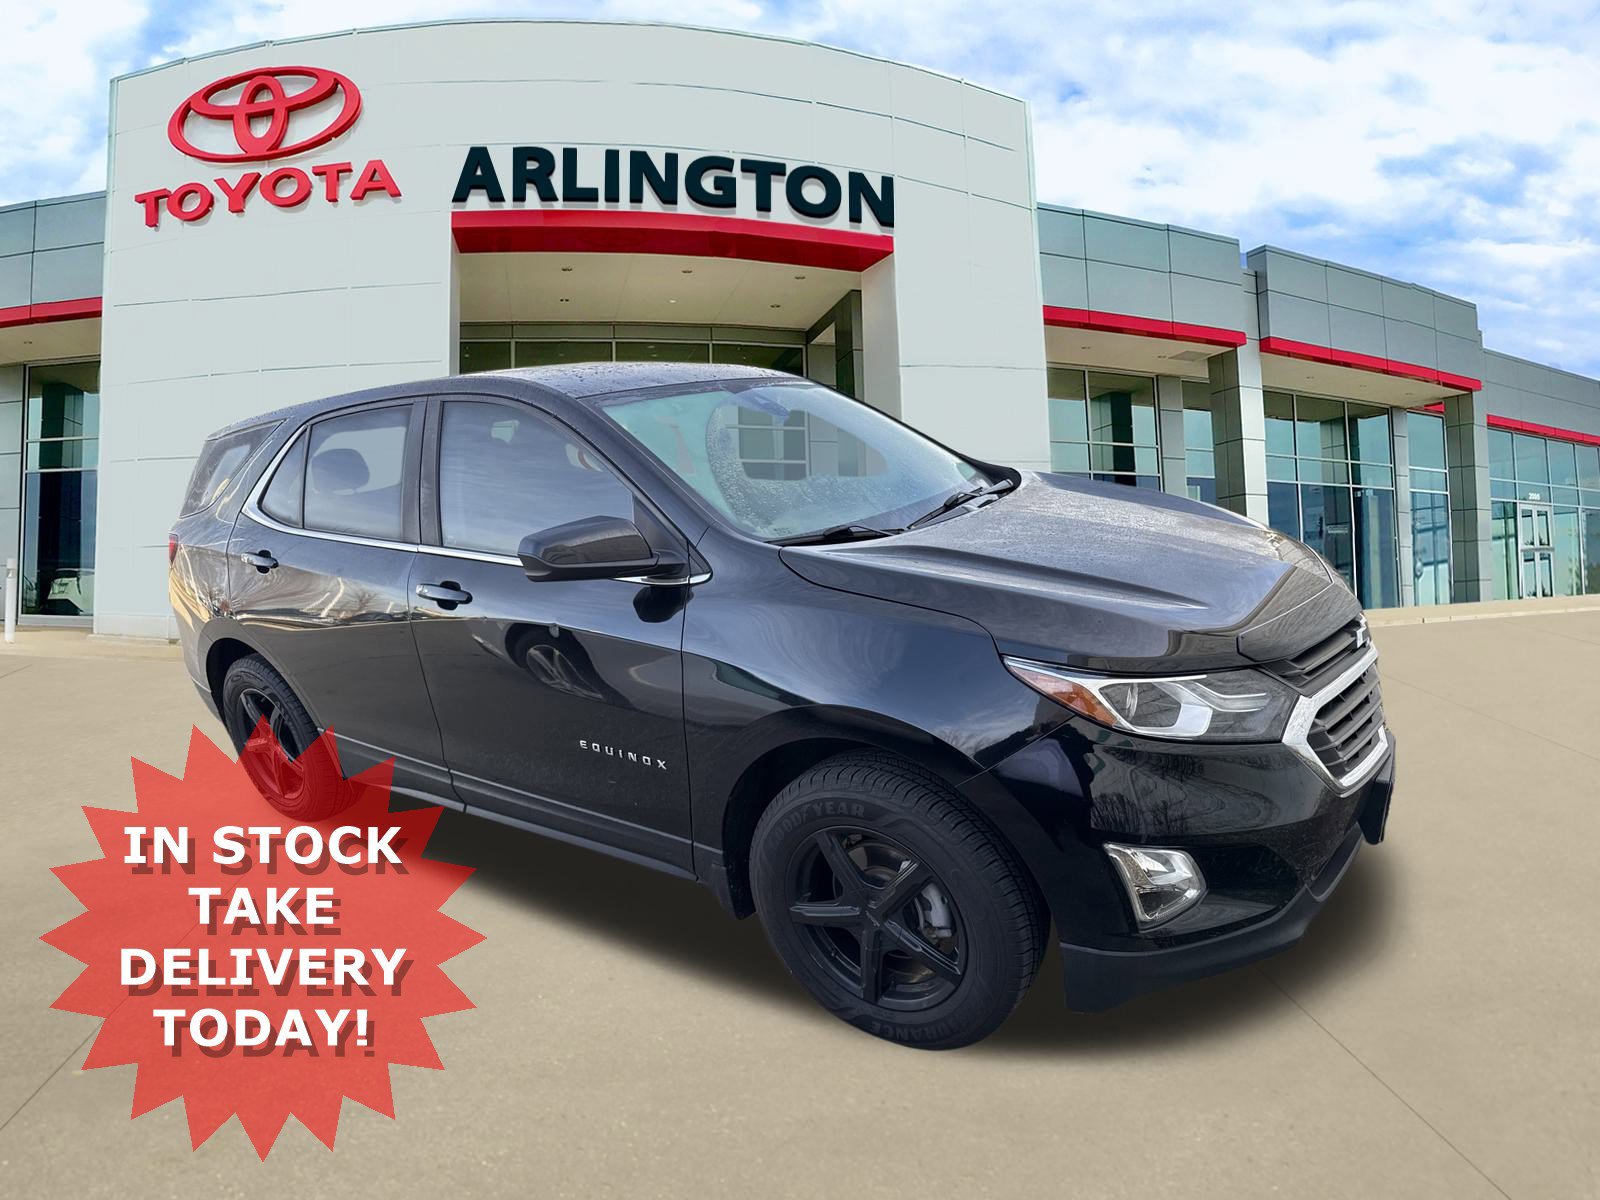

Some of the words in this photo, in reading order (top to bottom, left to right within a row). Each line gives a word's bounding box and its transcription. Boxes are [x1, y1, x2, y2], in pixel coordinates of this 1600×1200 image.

[135, 159, 402, 229] TOYOTA
[452, 146, 895, 228] ARLINGTON
[579, 739, 668, 771] EQUINOX
